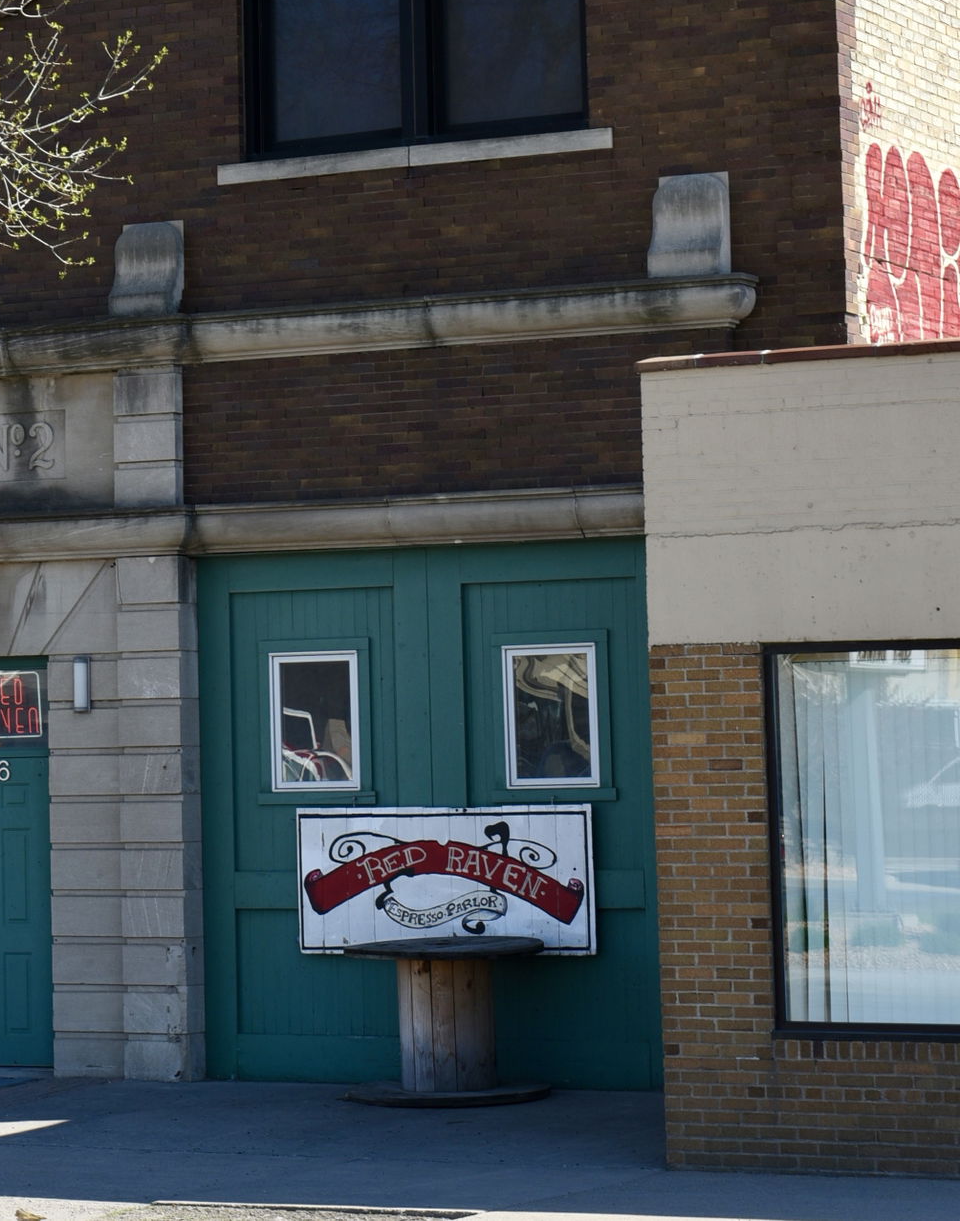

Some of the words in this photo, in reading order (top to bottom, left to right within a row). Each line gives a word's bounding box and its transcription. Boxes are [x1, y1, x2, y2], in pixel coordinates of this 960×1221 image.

[356, 846, 427, 885] RED
[445, 846, 549, 899] RAVEN
[387, 902, 444, 925] ESPRESSO
[446, 895, 498, 917] PARLOR
